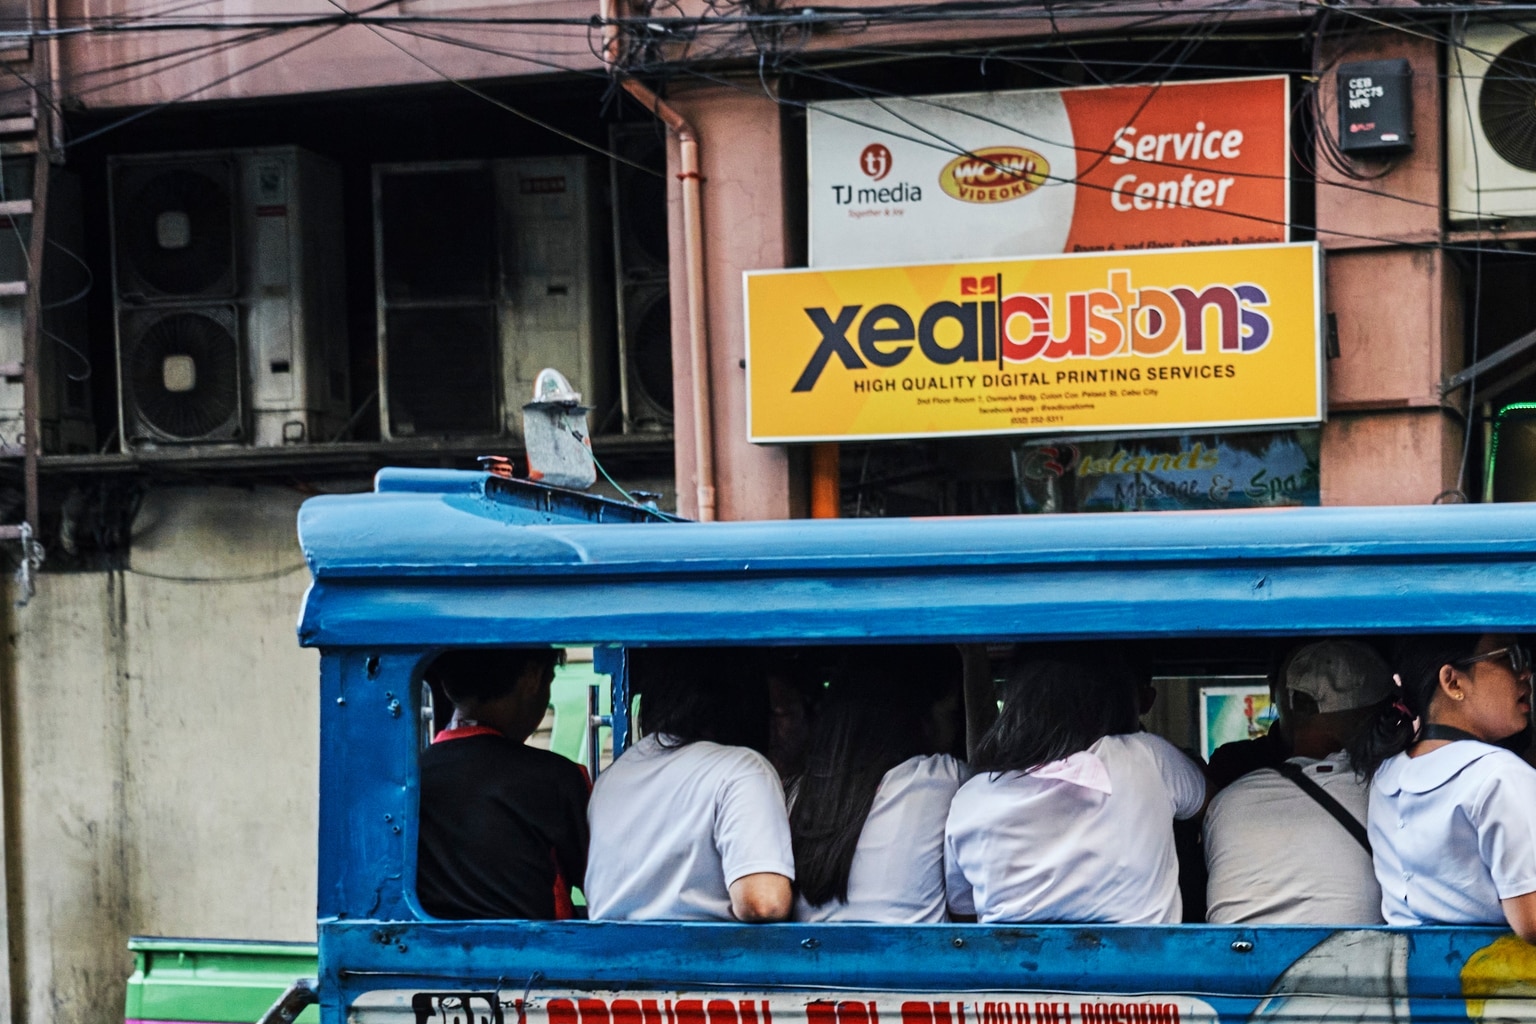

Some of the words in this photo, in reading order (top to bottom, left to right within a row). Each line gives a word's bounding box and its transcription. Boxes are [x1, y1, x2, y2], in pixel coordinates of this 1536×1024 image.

[1109, 121, 1243, 165] Service
[832, 185, 852, 205] TJ
[857, 182, 922, 204] media
[957, 181, 1034, 200] VIDEOKE
[1111, 173, 1235, 212] Center
[999, 269, 1272, 365] customs
[854, 378, 896, 393] HIGH
[902, 374, 976, 391] QUALITY
[983, 370, 1050, 388] DIGITAL
[1056, 366, 1141, 385] PRINTING
[1147, 363, 1236, 382] SERVICES
[1114, 475, 1199, 506] Massage
[1208, 474, 1233, 502] &
[1245, 469, 1297, 500] Spa
